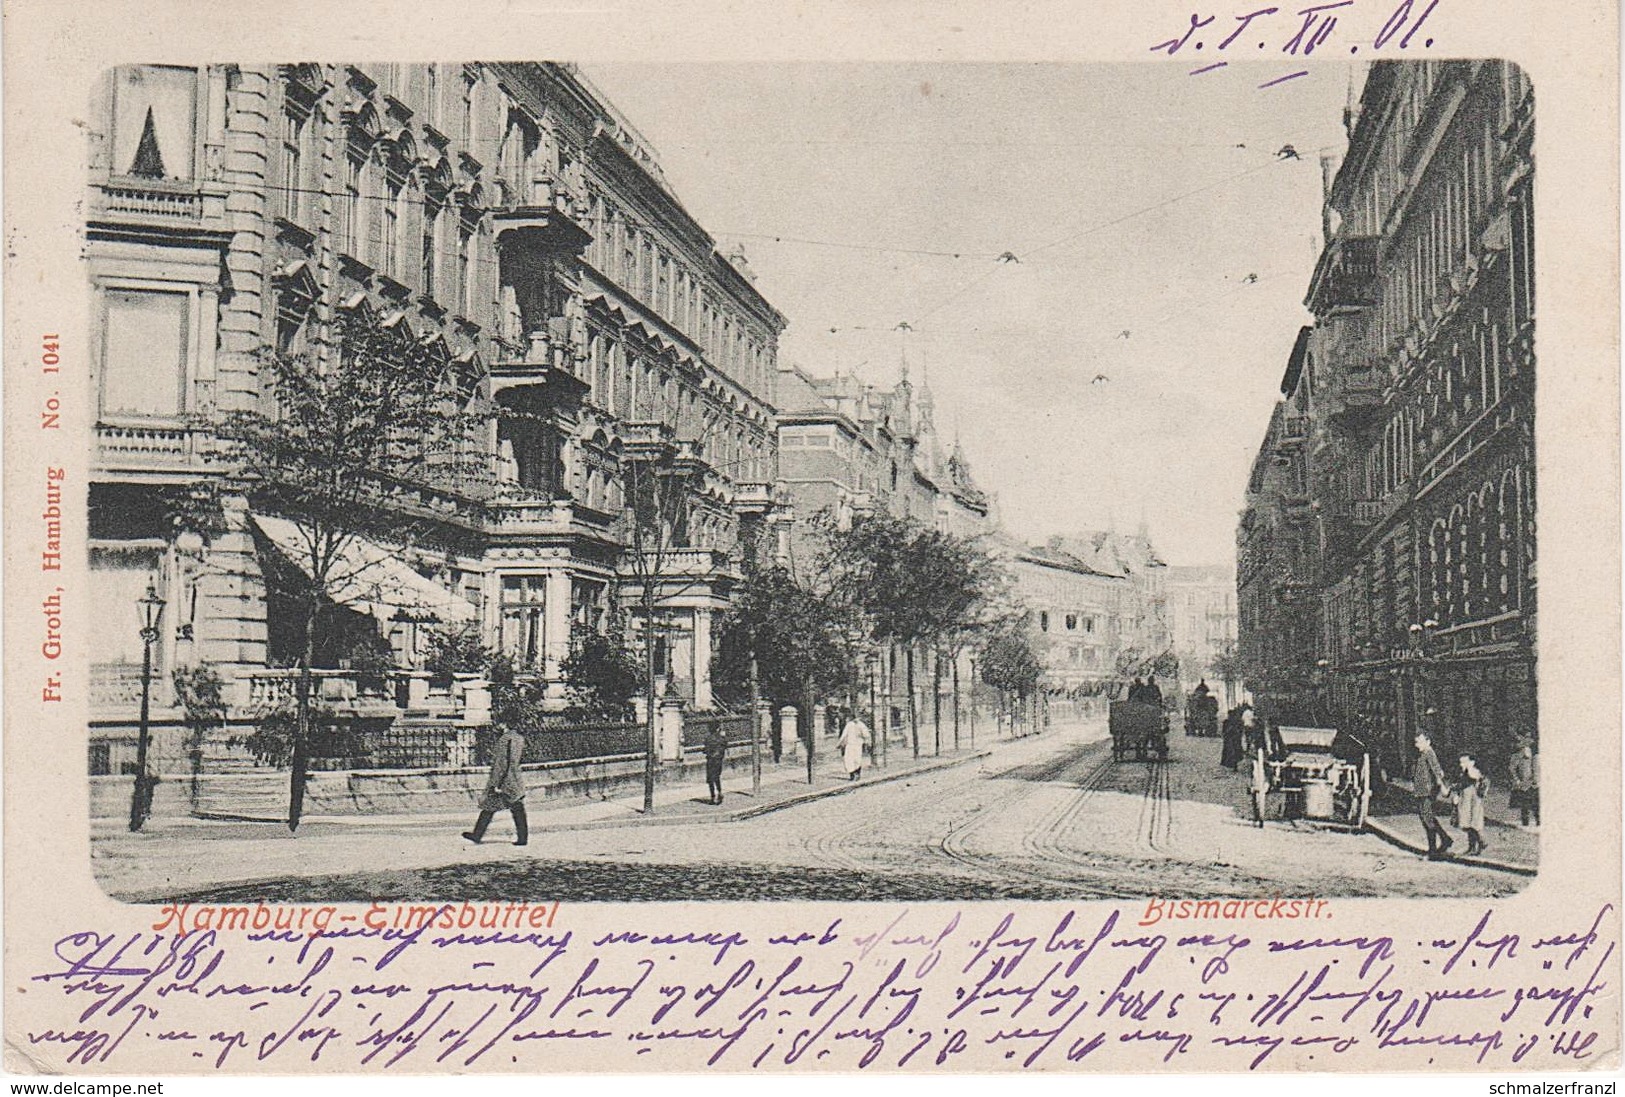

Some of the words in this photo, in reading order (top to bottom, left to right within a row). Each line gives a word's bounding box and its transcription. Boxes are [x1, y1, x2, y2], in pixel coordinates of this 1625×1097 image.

[43, 333, 60, 373] 1041
[43, 390, 60, 429] No.
[43, 466, 64, 571] Hamburg
[42, 585, 64, 660] Groth,
[43, 669, 61, 702] Fr.
[1138, 890, 1333, 926] Bismarckstr.
[436, 1003, 497, 1063] so
[464, 994, 612, 1066] mich
[984, 1001, 1087, 1068] für
